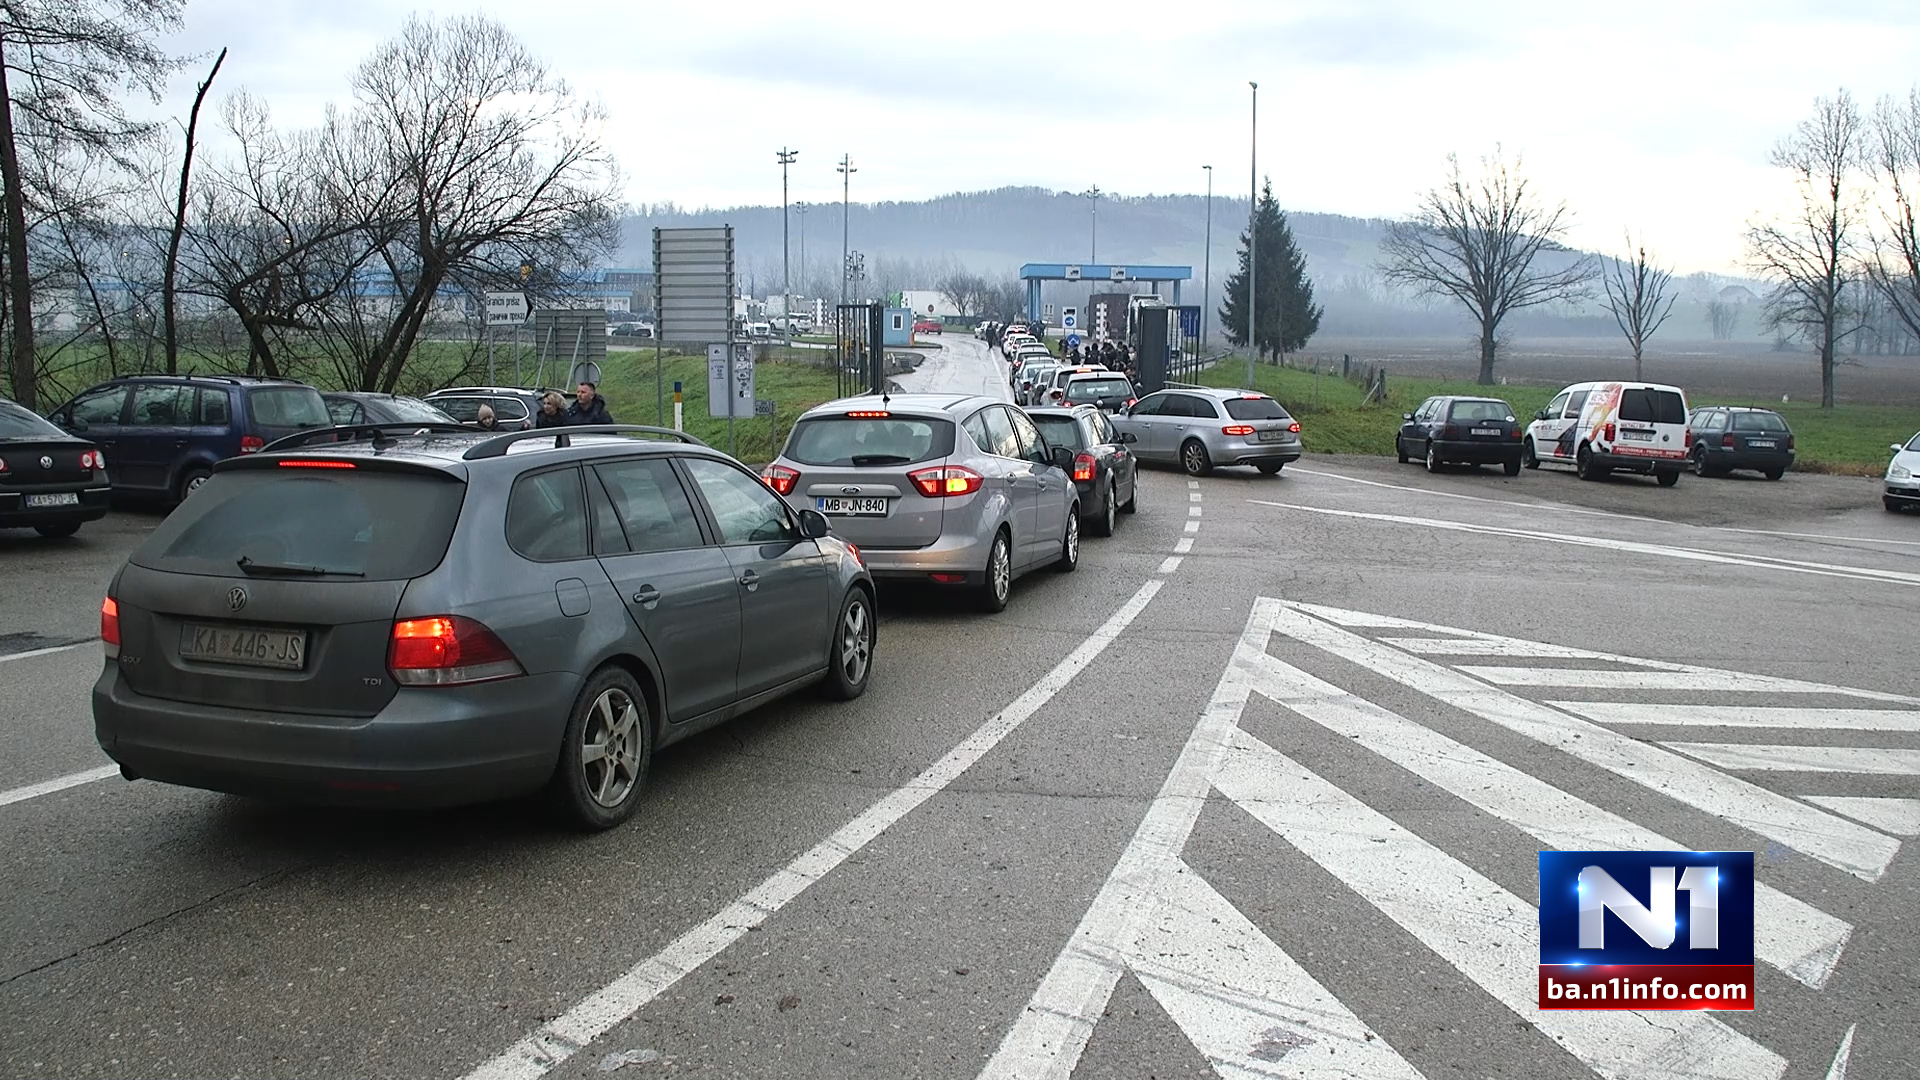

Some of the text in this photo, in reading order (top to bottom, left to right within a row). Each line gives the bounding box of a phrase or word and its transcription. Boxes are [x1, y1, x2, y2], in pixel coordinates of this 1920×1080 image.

[32, 495, 43, 506] KA
[825, 499, 885, 511] MB JN-840
[194, 627, 302, 661] KA 446-JS
[122, 655, 142, 664] GOLF
[363, 677, 382, 686] TDI
